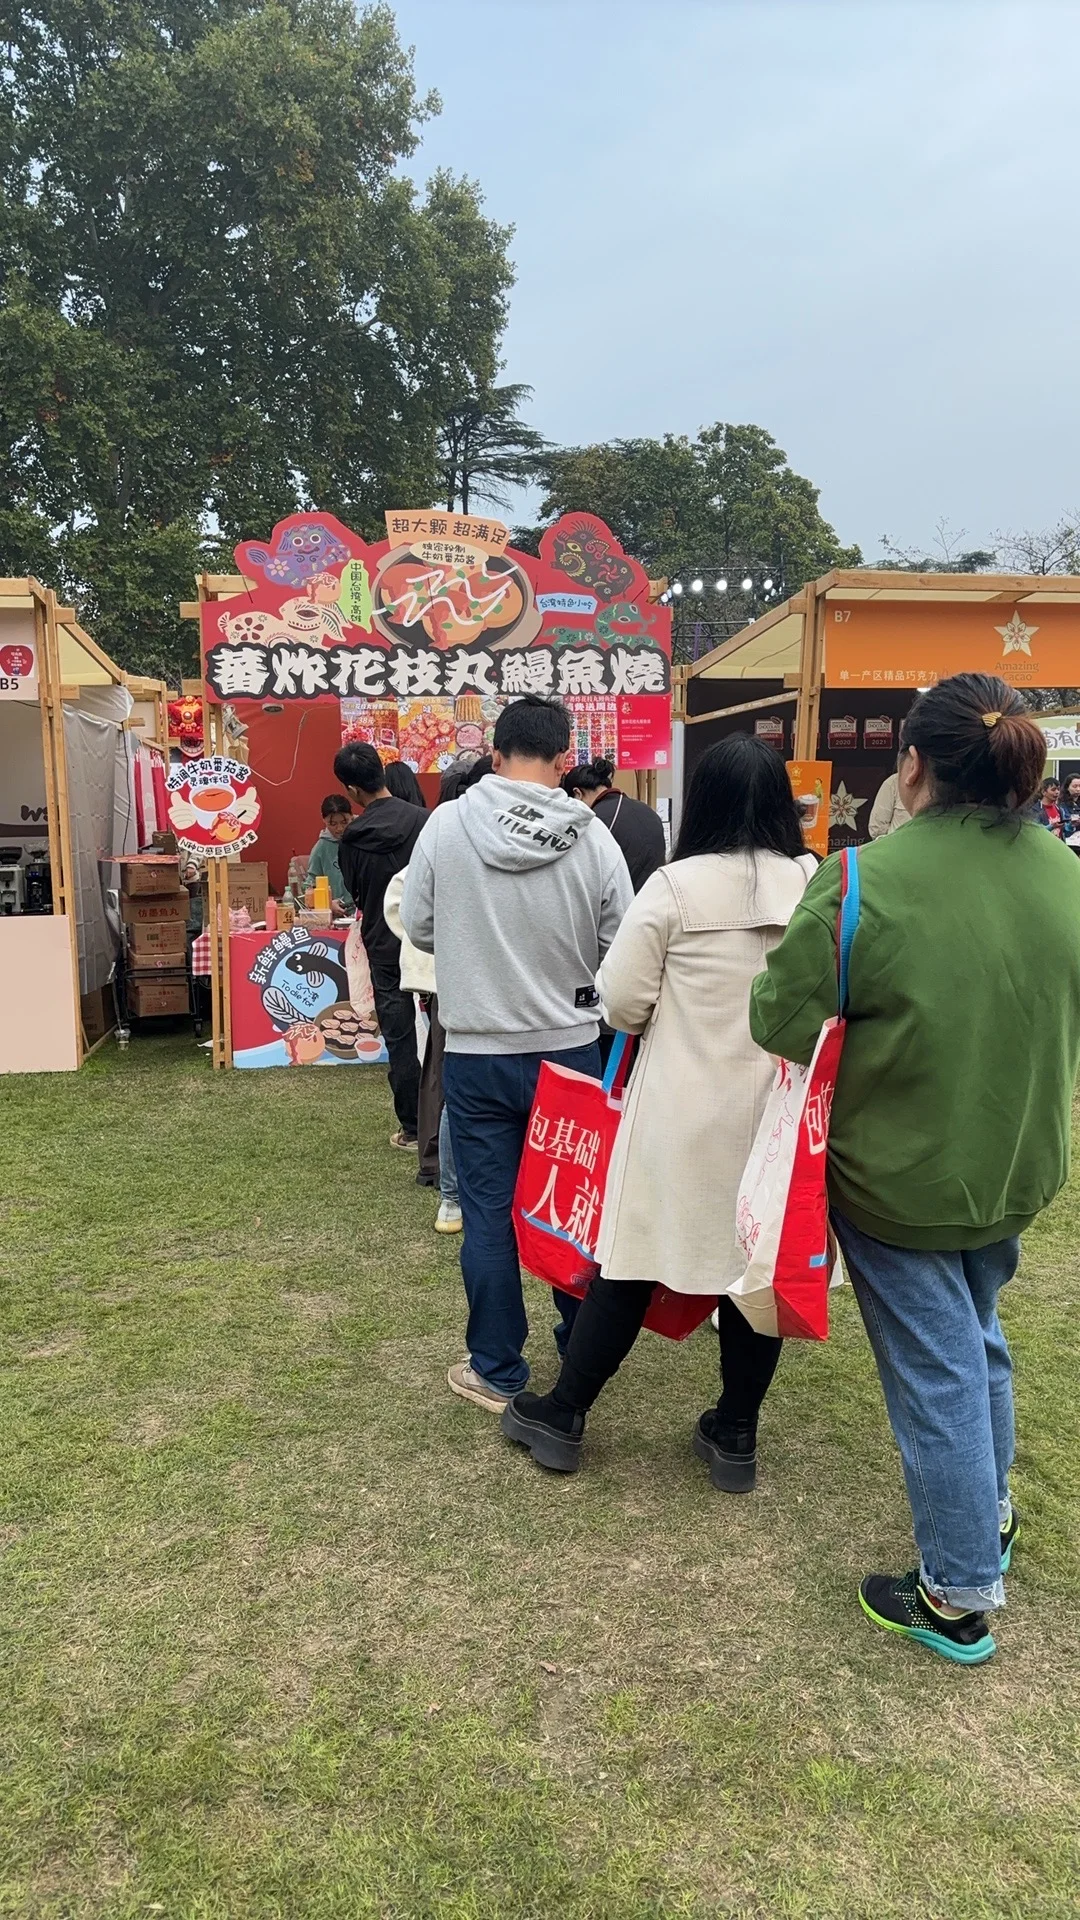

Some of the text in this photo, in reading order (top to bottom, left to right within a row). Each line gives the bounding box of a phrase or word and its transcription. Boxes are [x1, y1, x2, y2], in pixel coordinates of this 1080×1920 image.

[392, 517, 507, 545] 超大颗 超满足
[421, 551, 475, 565] 牛奶番茄酱
[834, 610, 851, 623] B7
[995, 661, 1039, 672] Amazing
[839, 669, 938, 681] 单一产区精品巧克力
[1003, 672, 1033, 682] Cacao
[0, 677, 19, 690] B5
[167, 758, 248, 789] 特调牛奶番茄酱
[190, 776, 230, 786] 灵魂伴侣
[249, 926, 311, 984] 新鲜鳗鱼
[528, 1105, 601, 1174] 包基础
